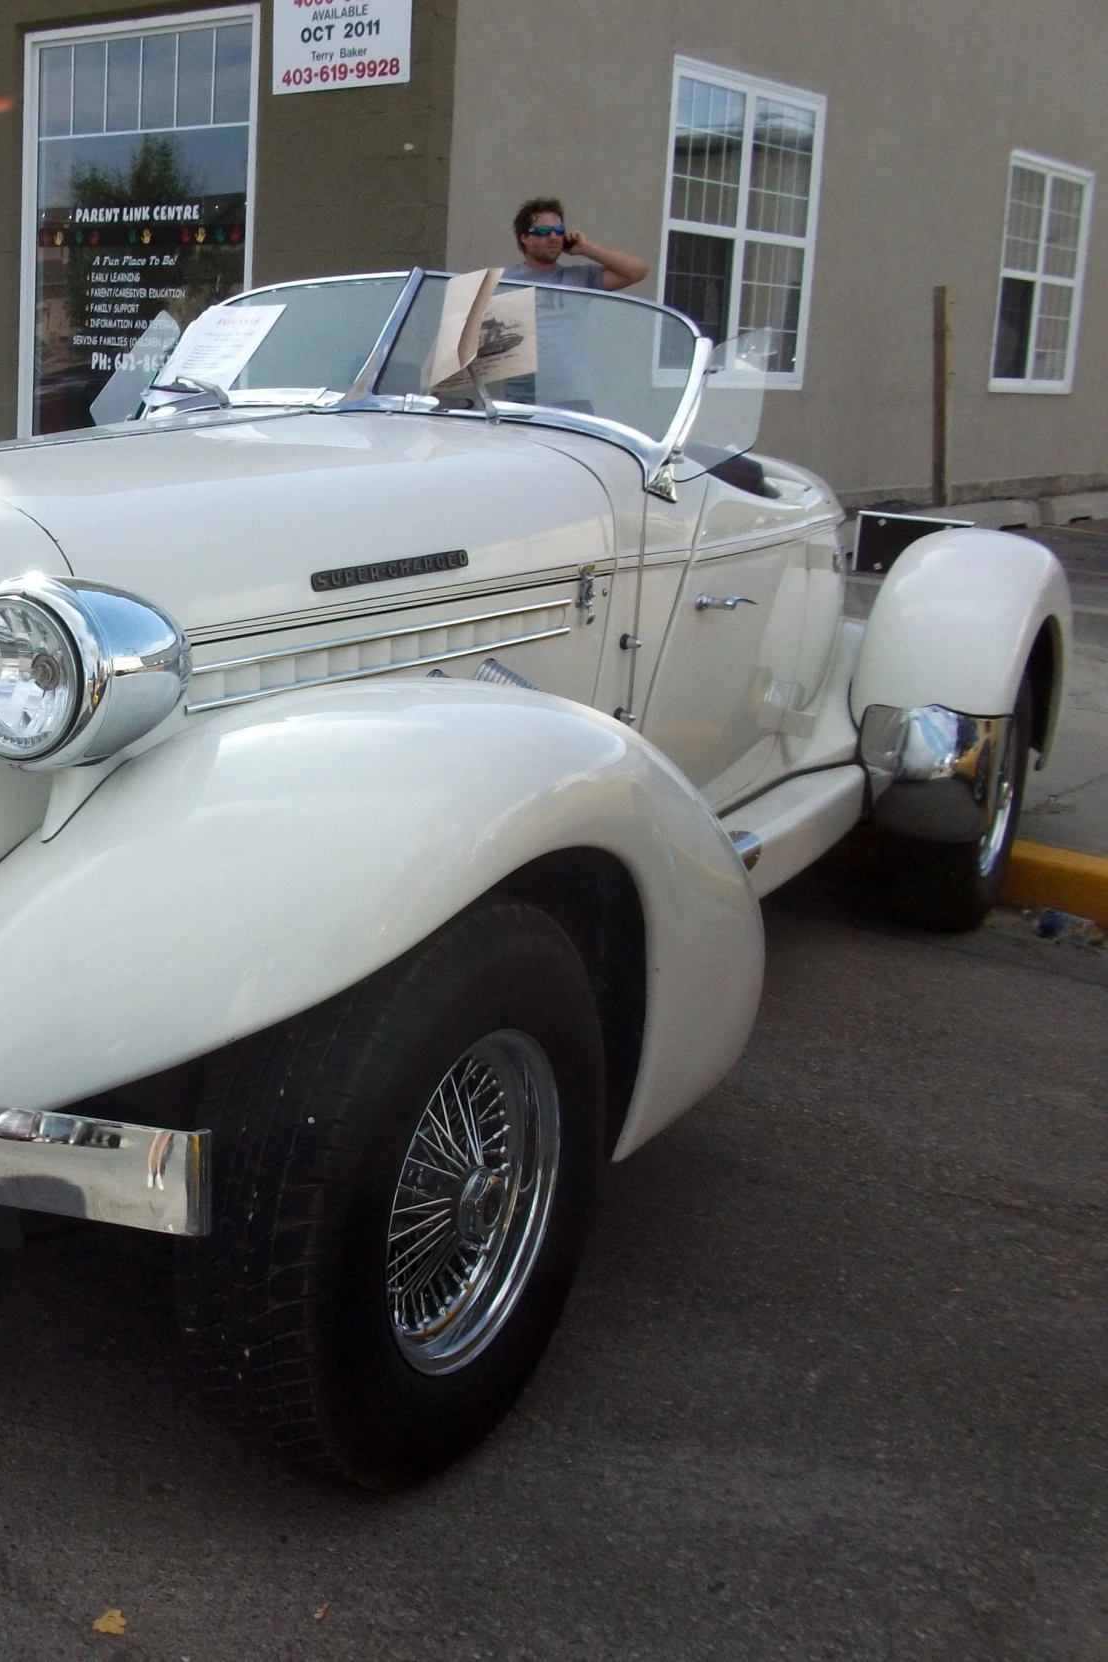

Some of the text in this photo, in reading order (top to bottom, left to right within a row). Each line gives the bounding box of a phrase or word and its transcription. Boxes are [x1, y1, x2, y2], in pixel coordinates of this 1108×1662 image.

[312, 4, 369, 21] AVAILABLE
[300, 19, 380, 43] OCT 2011
[311, 47, 367, 62] Terry Baker
[282, 57, 400, 86] 403-619-9928
[75, 204, 200, 223] PARENT LINK CENTRE
[93, 253, 180, 266] A Fun Place To Be!
[91, 272, 141, 282] EARLY LEARNING
[91, 287, 186, 298] PARENT/CAREGIVER EDUCATION
[90, 303, 140, 313] FAMILY SUPPORT
[90, 319, 132, 329] INFORMATION
[134, 319, 148, 329] AND
[73, 335, 98, 345] SERVING
[99, 336, 128, 347] FAMILIES
[91, 352, 112, 371] PH:
